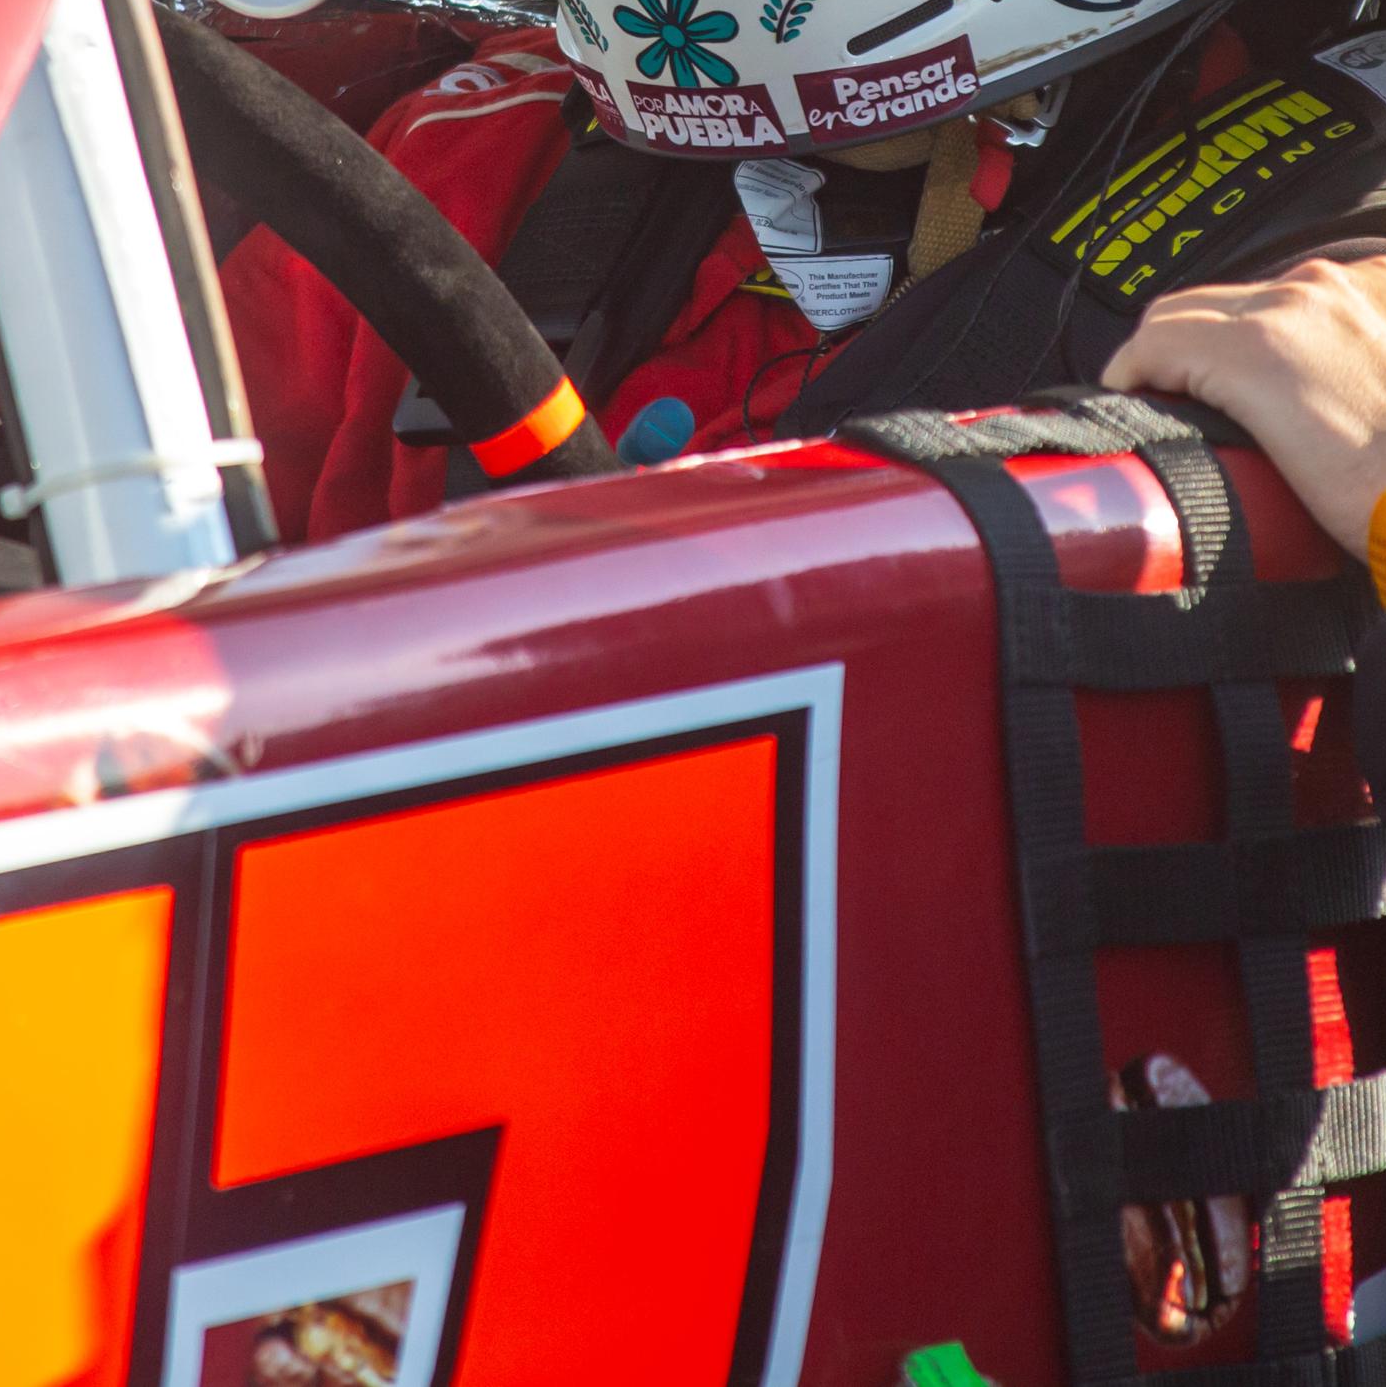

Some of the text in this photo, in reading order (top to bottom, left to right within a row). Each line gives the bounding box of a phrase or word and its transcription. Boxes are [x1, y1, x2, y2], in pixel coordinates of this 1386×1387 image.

[833, 56, 957, 106] Pensar
[632, 94, 664, 114] POR
[662, 93, 747, 117] AMOR
[845, 71, 978, 127] Grande
[639, 111, 786, 147] PUEBLA
[1119, 121, 1356, 296] RACING
[809, 271, 878, 281] This Manufacturer
[809, 282, 841, 291] Certifies
[844, 281, 862, 290] That
[863, 280, 878, 289] This
[816, 292, 848, 301] Product
